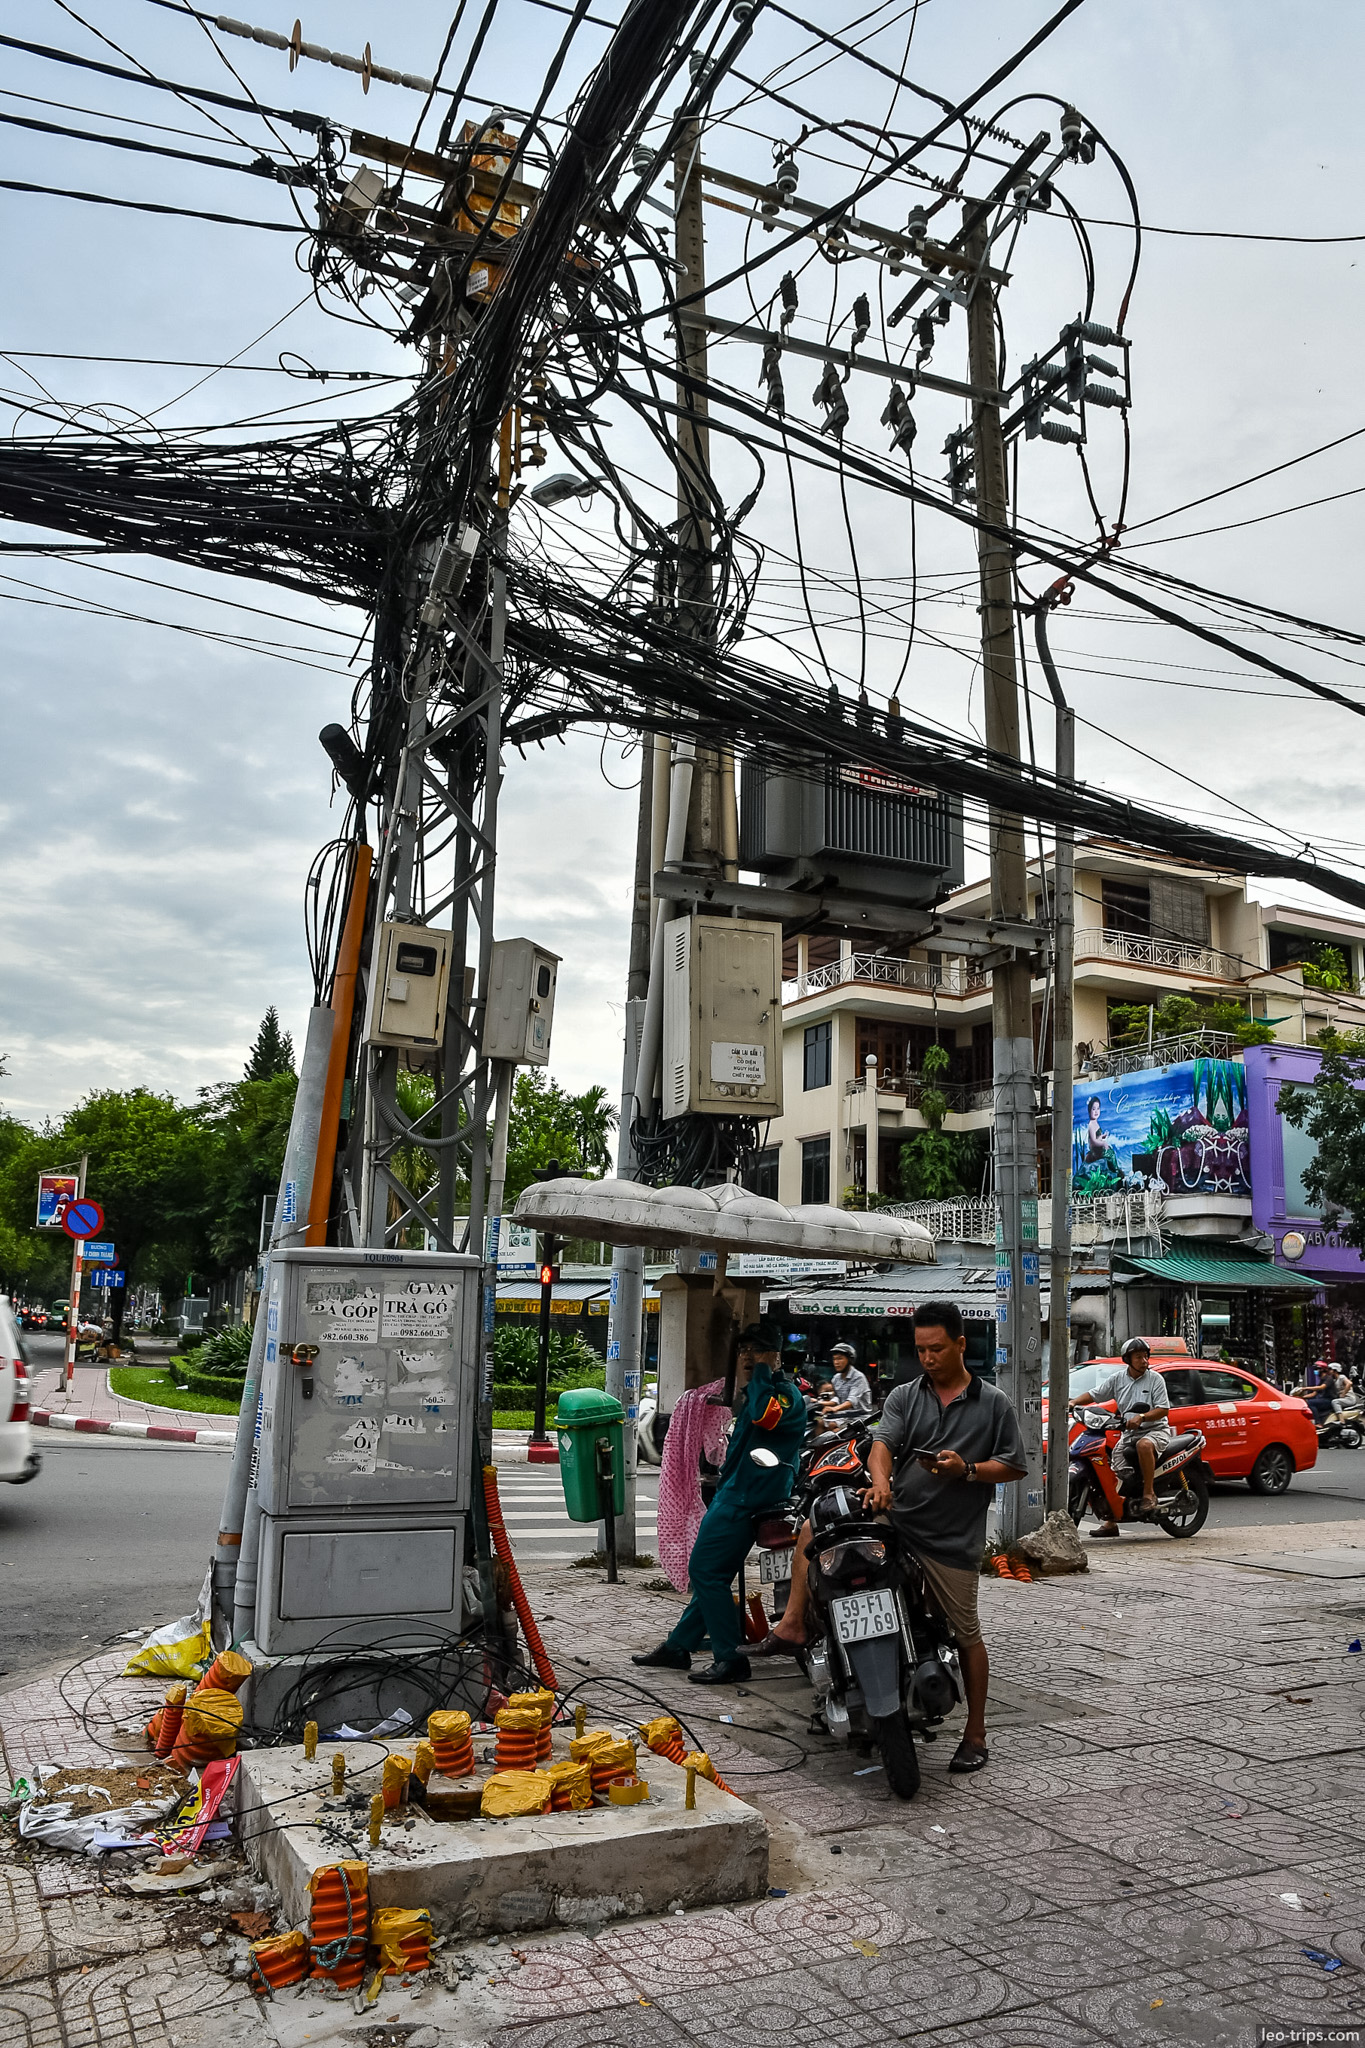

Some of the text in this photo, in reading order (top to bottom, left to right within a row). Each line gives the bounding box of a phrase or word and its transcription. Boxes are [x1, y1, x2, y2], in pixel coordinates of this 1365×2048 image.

[342, 1302, 379, 1319] GÓP
[385, 1298, 418, 1314] TRẢ
[321, 1333, 369, 1342] 982.660.386
[1205, 1417, 1247, 1429] 38.18.18.18
[841, 1594, 884, 1619] 59-F1
[839, 1612, 895, 1640] 577.69
